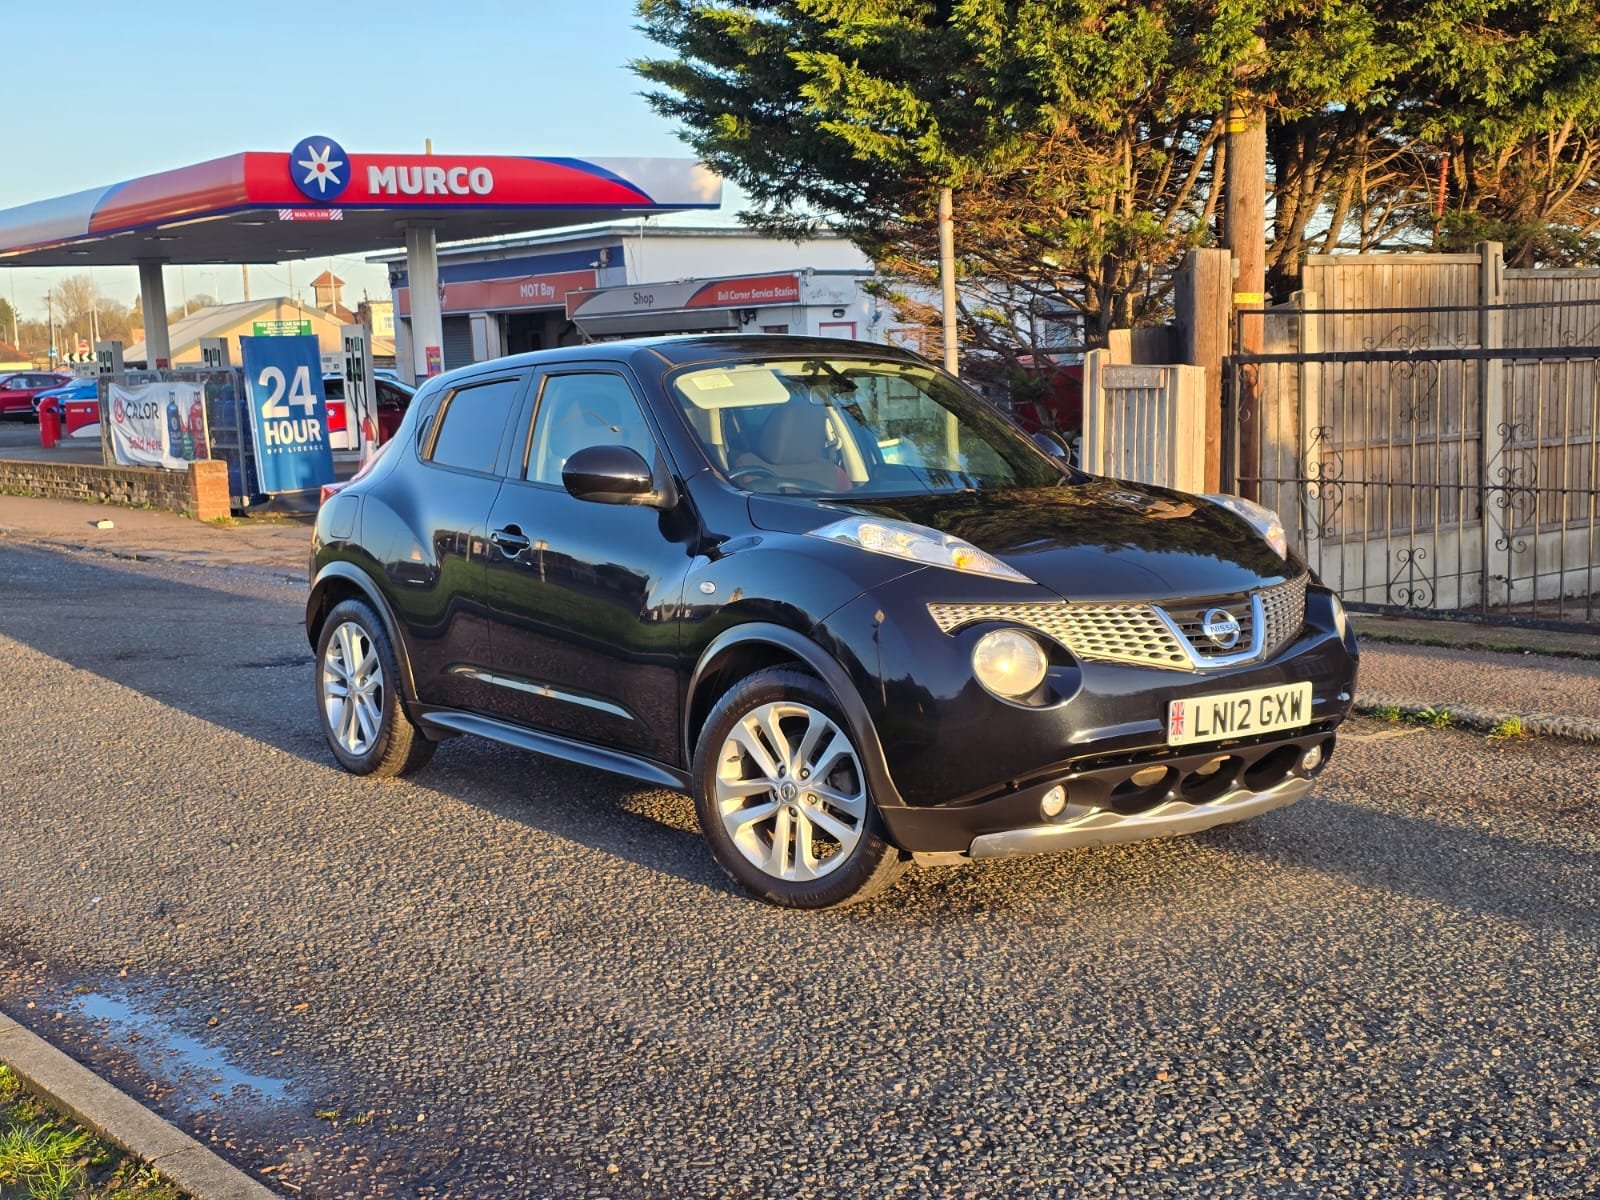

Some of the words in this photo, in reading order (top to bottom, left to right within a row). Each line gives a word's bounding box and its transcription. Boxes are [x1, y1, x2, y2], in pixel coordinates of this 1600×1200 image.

[367, 165, 494, 195] MURCO
[520, 284, 539, 297] MOT
[540, 282, 555, 298] Bay
[633, 291, 654, 307] Shop
[730, 290, 751, 301] Corner
[751, 288, 774, 299] Service
[774, 286, 797, 298] Station
[258, 365, 318, 419] 24
[126, 402, 160, 420] CALOR
[263, 418, 322, 446] HOUR
[1210, 621, 1240, 633] NISSAN
[1194, 698, 1251, 737] LN12
[1259, 690, 1303, 727] GXW
